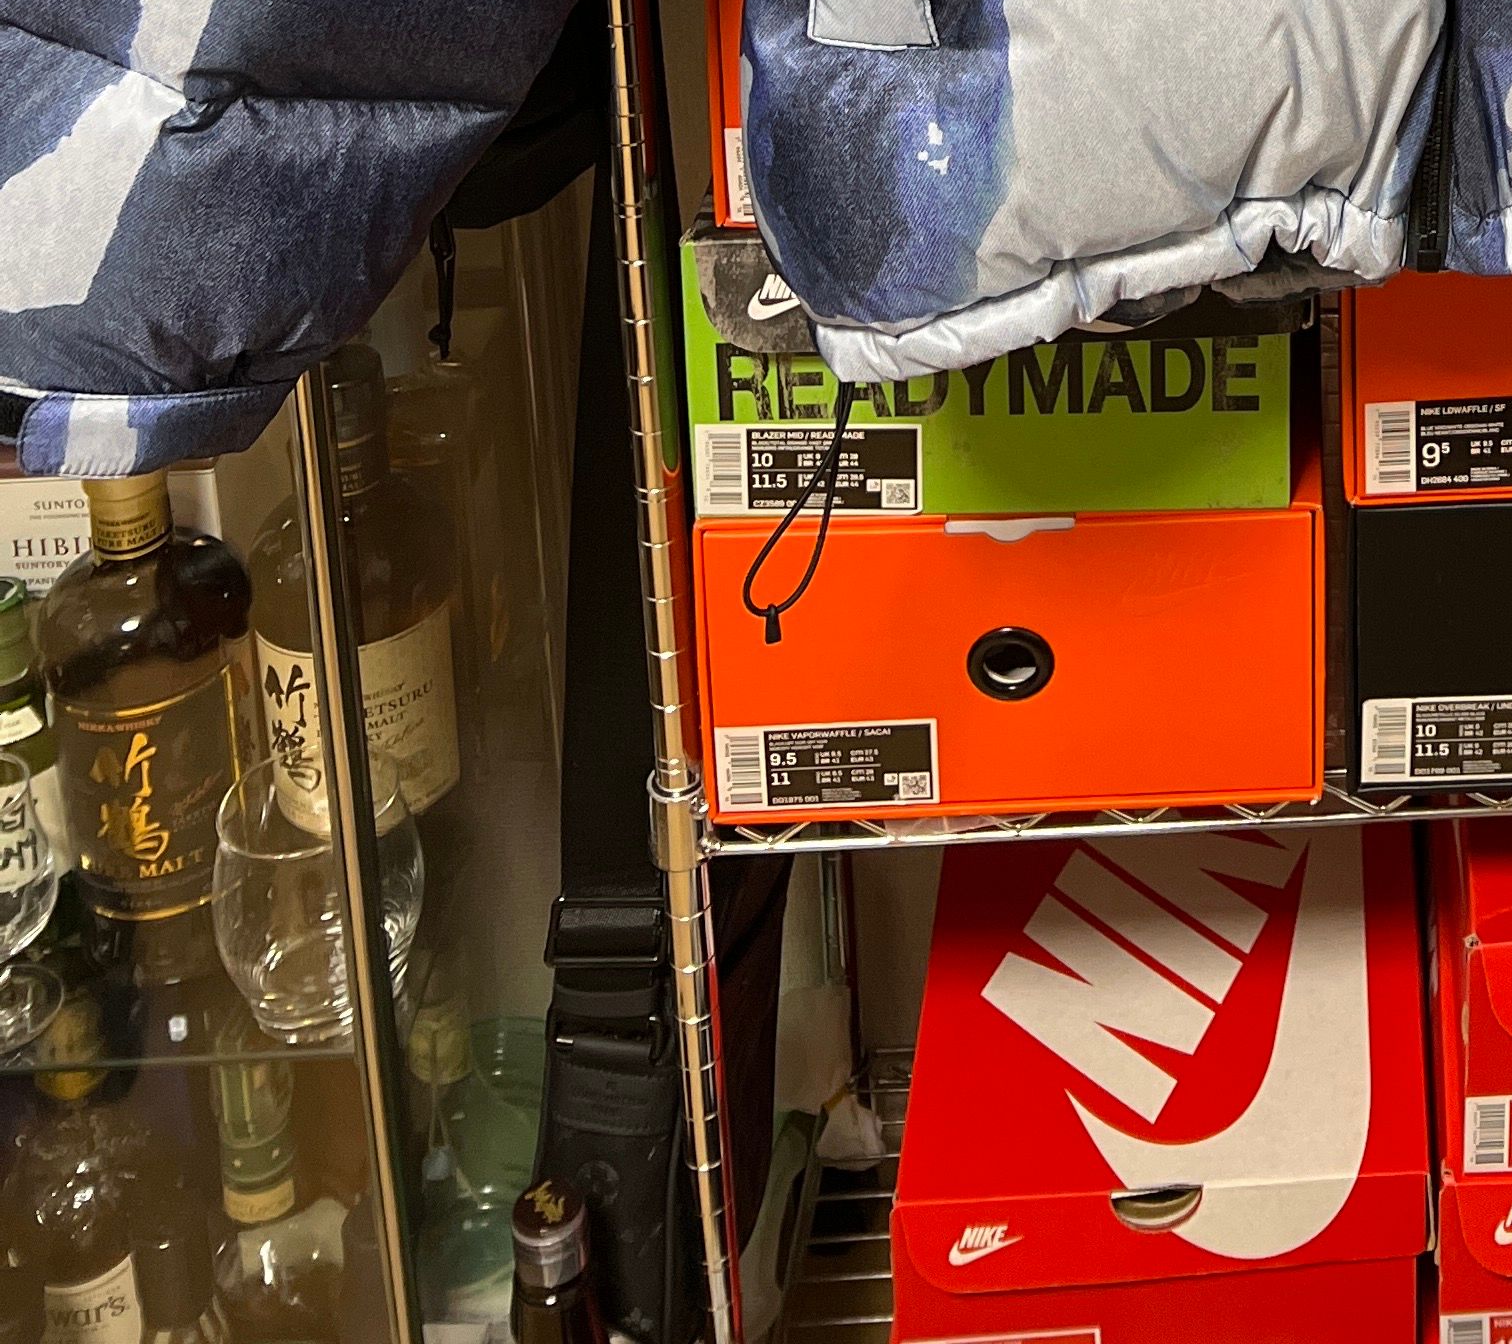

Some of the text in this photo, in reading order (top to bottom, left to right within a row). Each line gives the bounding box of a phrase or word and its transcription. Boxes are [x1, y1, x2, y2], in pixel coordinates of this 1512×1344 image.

[715, 330, 1262, 423] READYMADE
[751, 452, 773, 468] 10
[751, 473, 788, 489] 11.5
[1416, 724, 1437, 738] 10
[1415, 743, 1450, 758] 11.5
[769, 752, 798, 767] 9.5
[771, 772, 791, 786] 11
[959, 1221, 1009, 1251] NIKE
